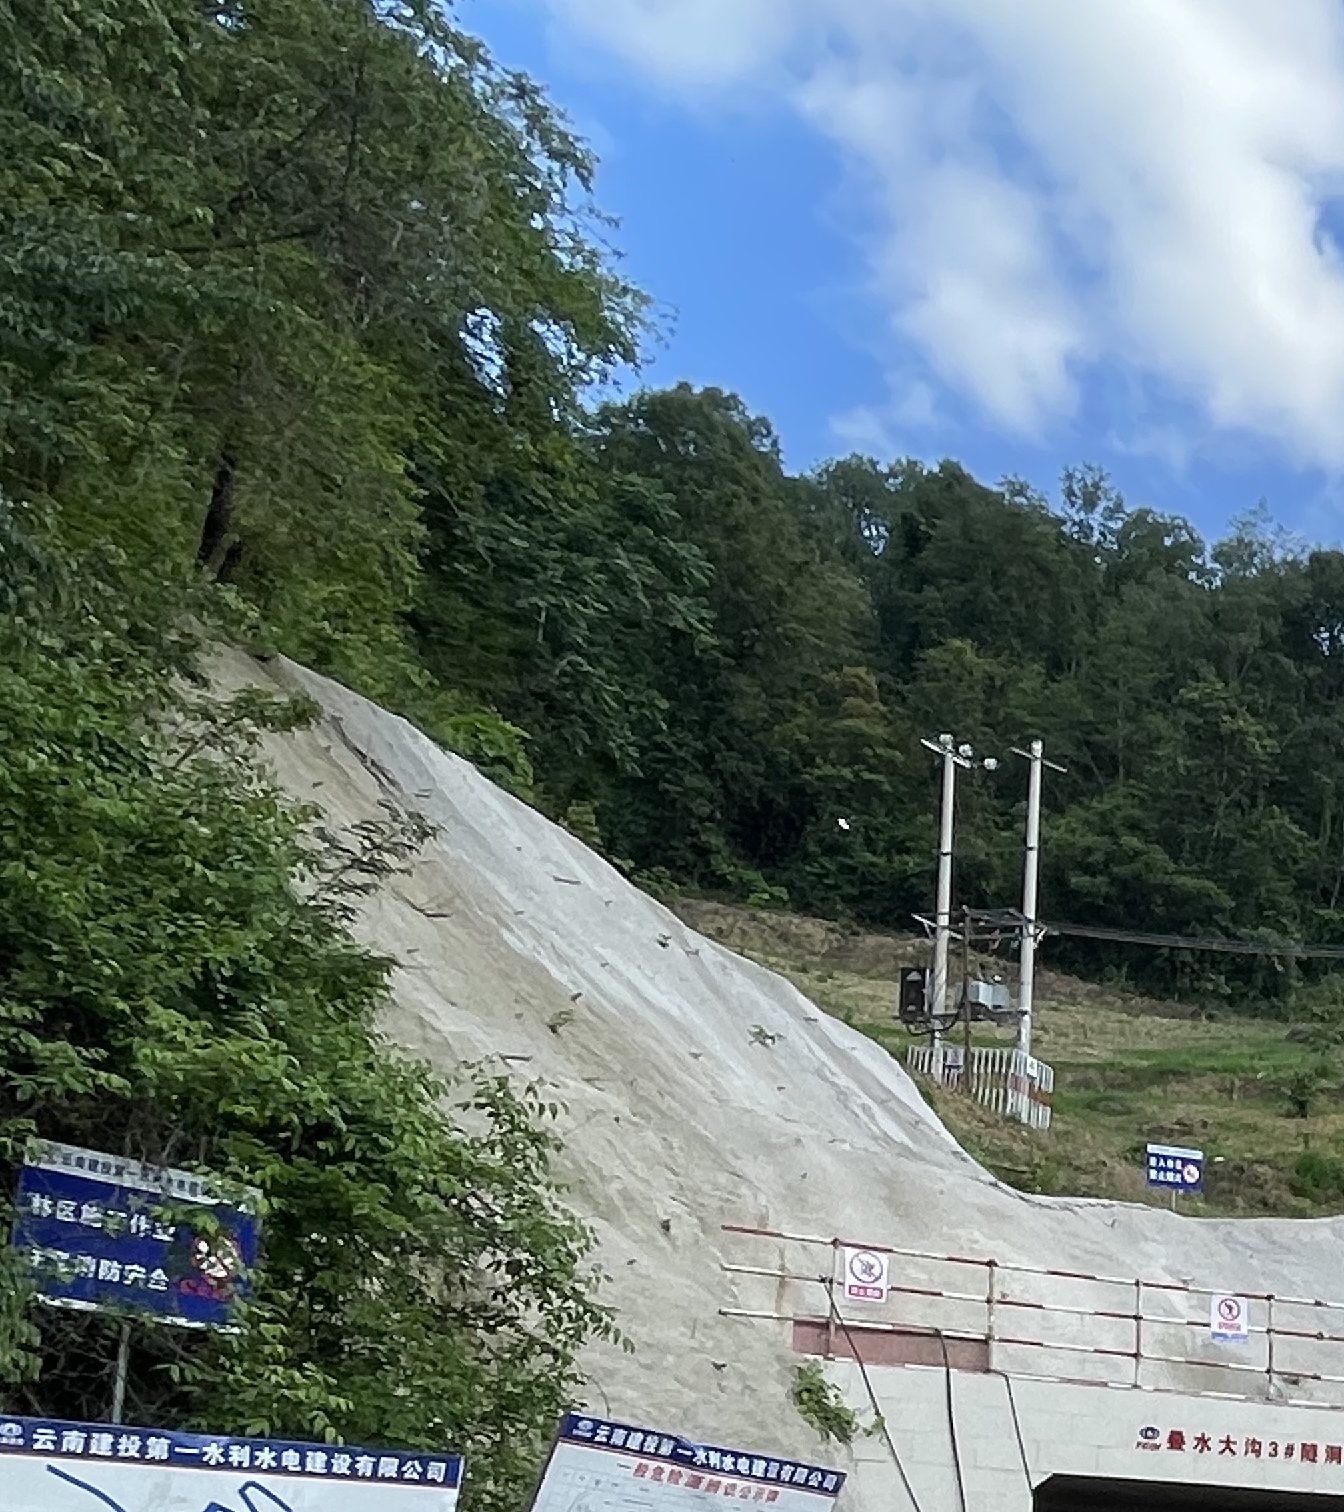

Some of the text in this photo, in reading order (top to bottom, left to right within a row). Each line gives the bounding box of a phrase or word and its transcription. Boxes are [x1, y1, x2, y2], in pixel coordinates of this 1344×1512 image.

[32, 1428, 447, 1483] 云南建投第一水利水电建设有限公司
